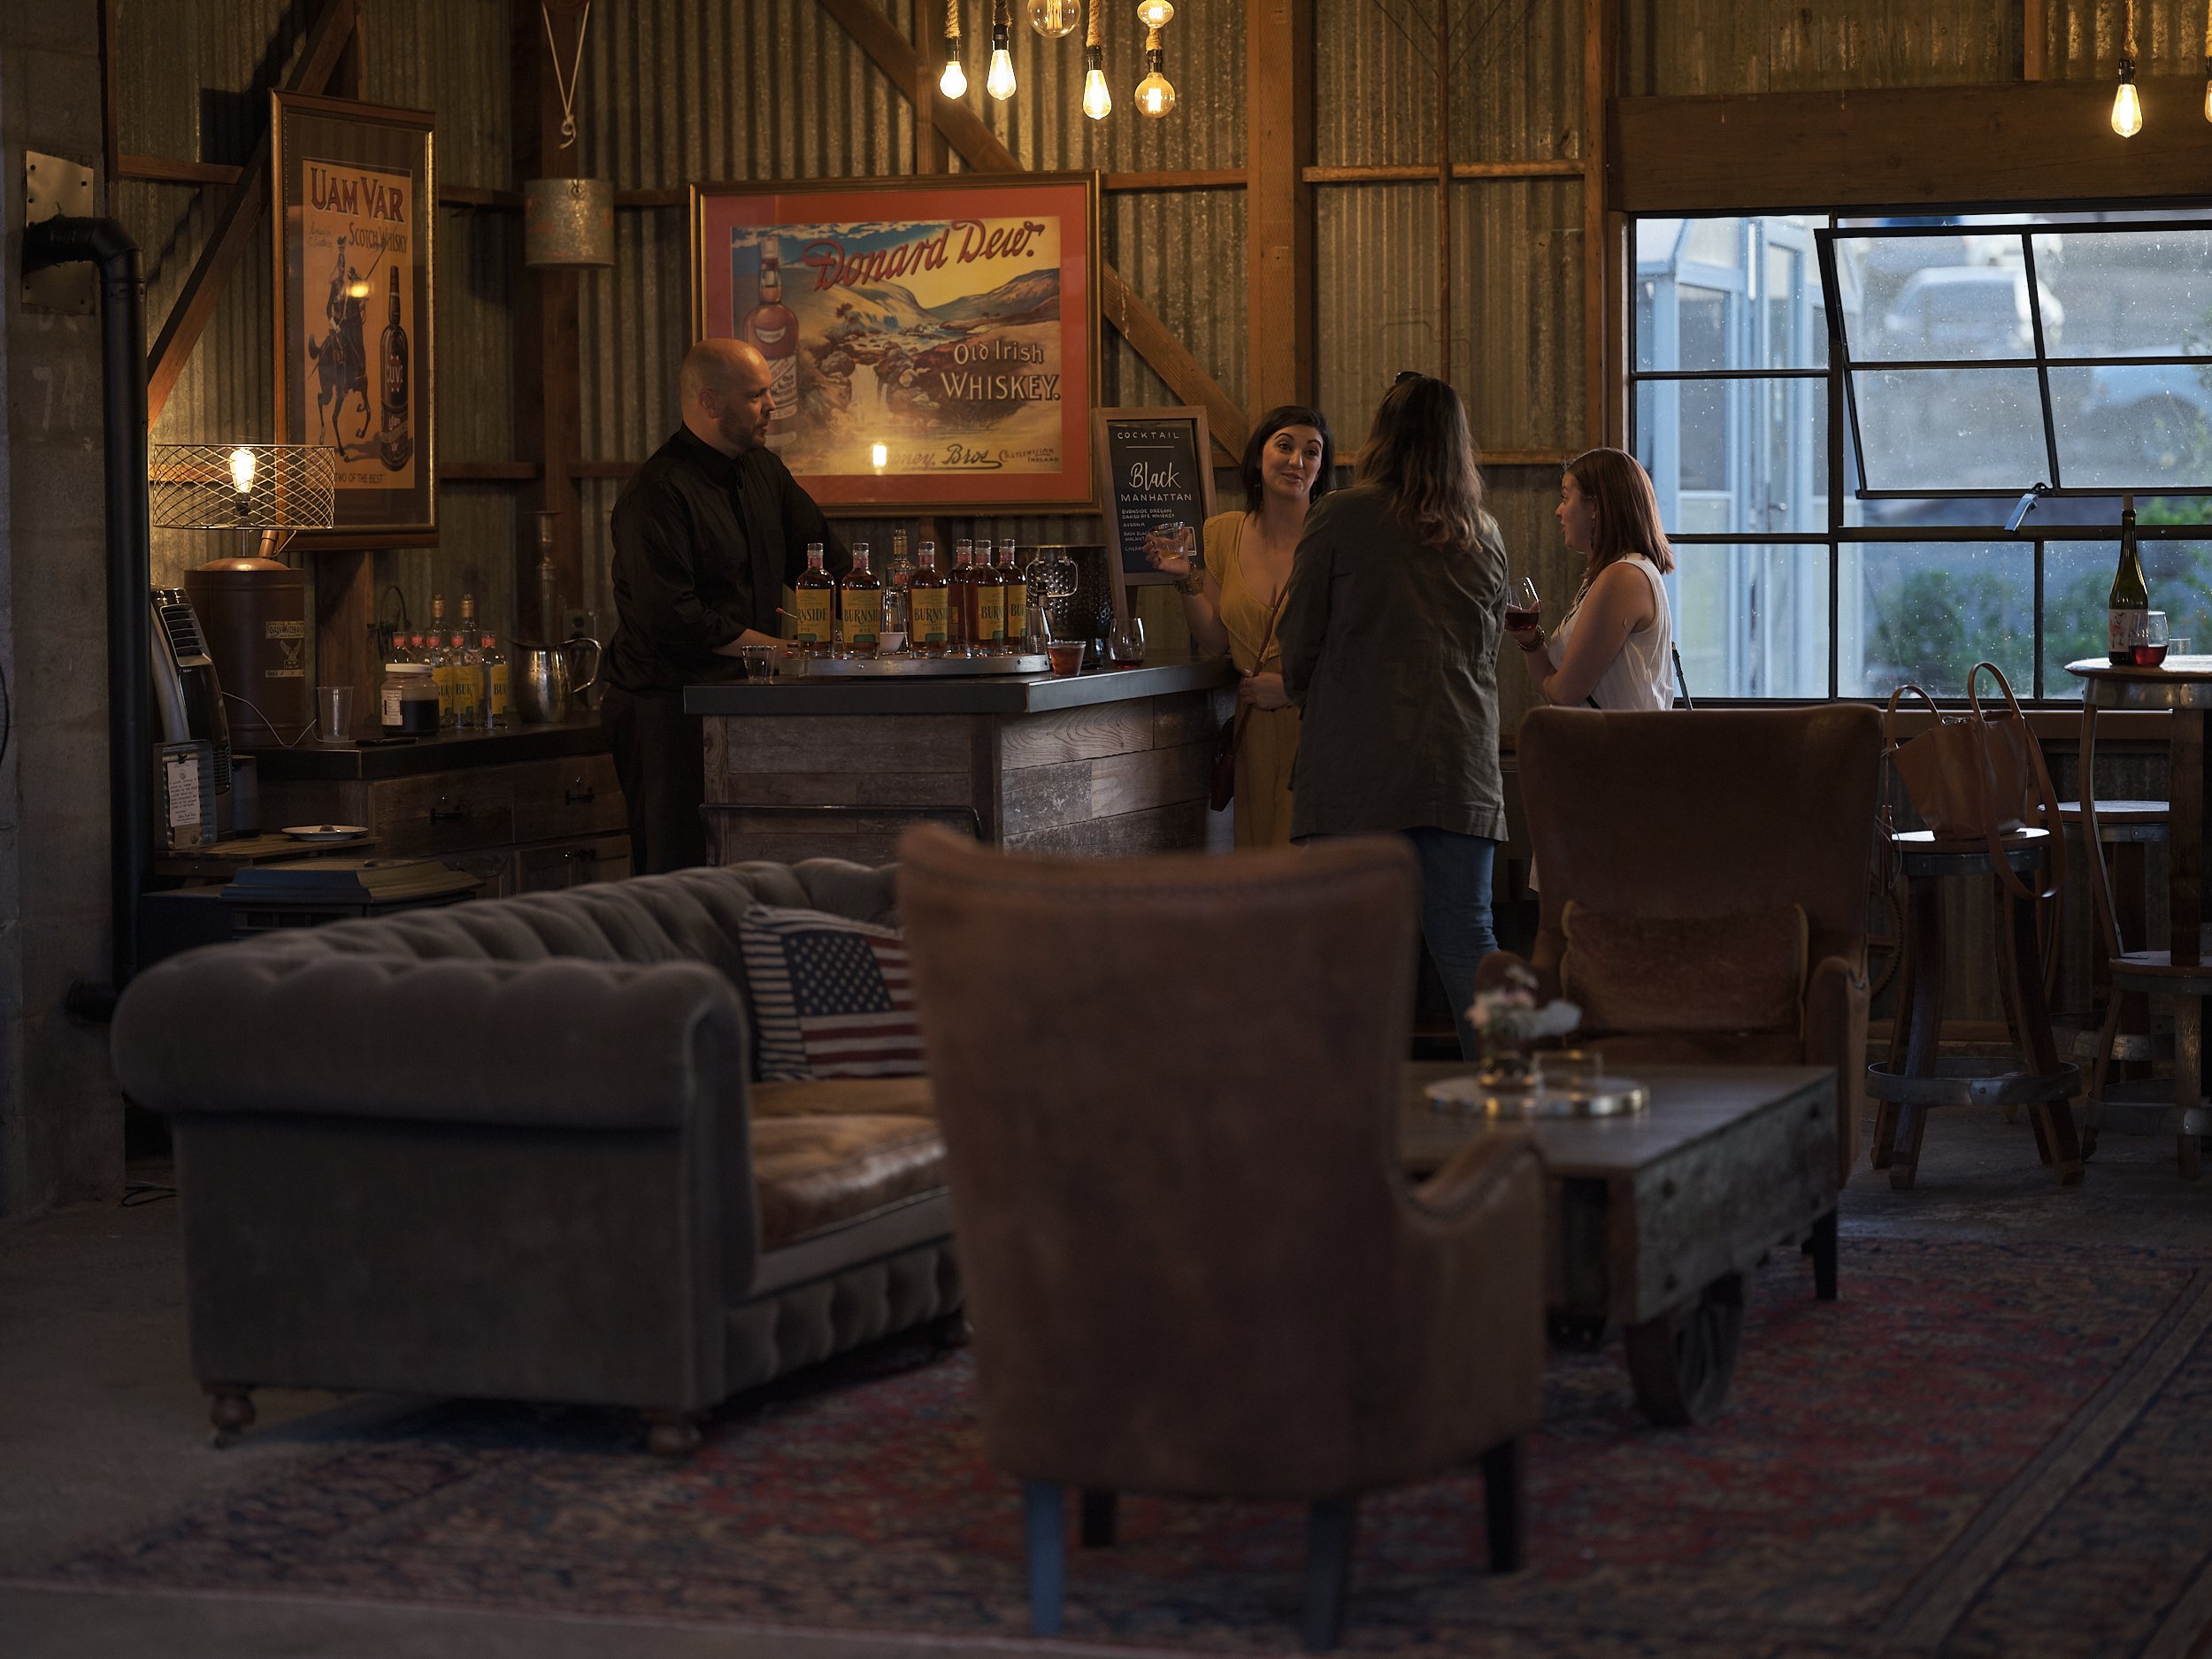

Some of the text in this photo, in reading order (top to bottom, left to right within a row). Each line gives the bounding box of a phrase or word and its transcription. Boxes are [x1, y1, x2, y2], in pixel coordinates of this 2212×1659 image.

[311, 167, 404, 223] UAM VAR
[349, 221, 378, 249] SCOTCH
[378, 227, 408, 253] WHISKY
[802, 219, 1046, 292] Donard Dew.
[954, 341, 1044, 365] Old Irish
[941, 372, 1061, 402] WHISKEY.
[941, 443, 998, 469] Bros
[357, 473, 368, 483] THE
[1129, 461, 1181, 491] Black
